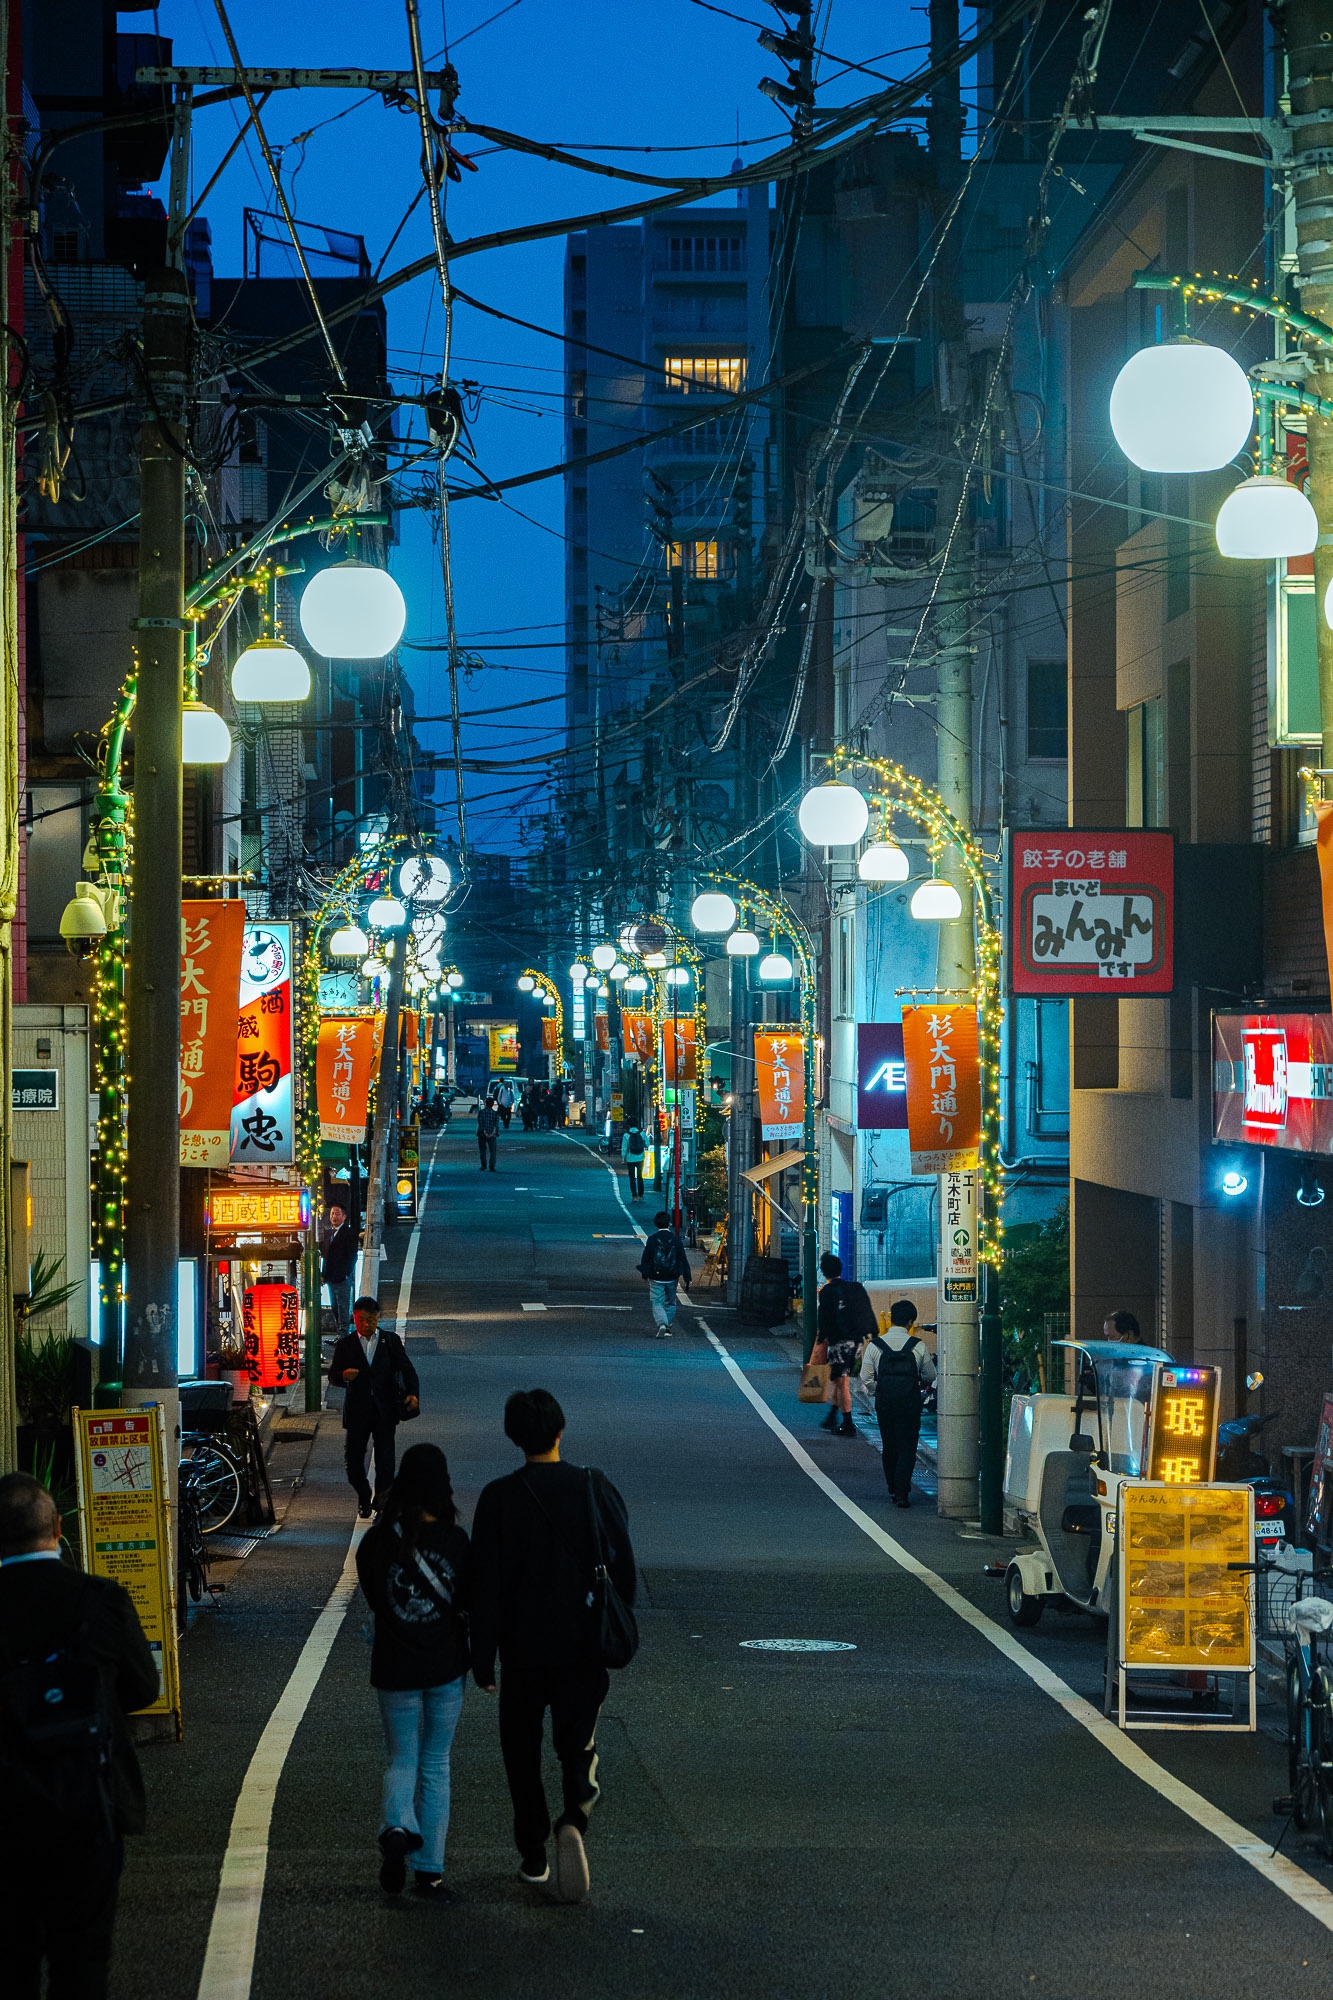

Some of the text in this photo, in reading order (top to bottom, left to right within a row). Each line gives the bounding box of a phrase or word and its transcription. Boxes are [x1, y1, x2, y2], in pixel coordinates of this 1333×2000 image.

[1022, 848, 1128, 869] 餃子の老舗
[1054, 880, 1100, 897] まいど
[1033, 896, 1153, 960] みんみん
[1100, 961, 1133, 977] です
[331, 1024, 358, 1120] 杉大門通り
[769, 1039, 793, 1121] 杉大門通り
[925, 1014, 960, 1143] 杉大門通り
[180, 1133, 222, 1147] と憩いの
[947, 1172, 961, 1225] 荒木町店
[946, 1282, 975, 1291] 杉大門通り
[1261, 1527, 1283, 1535] 48-61
